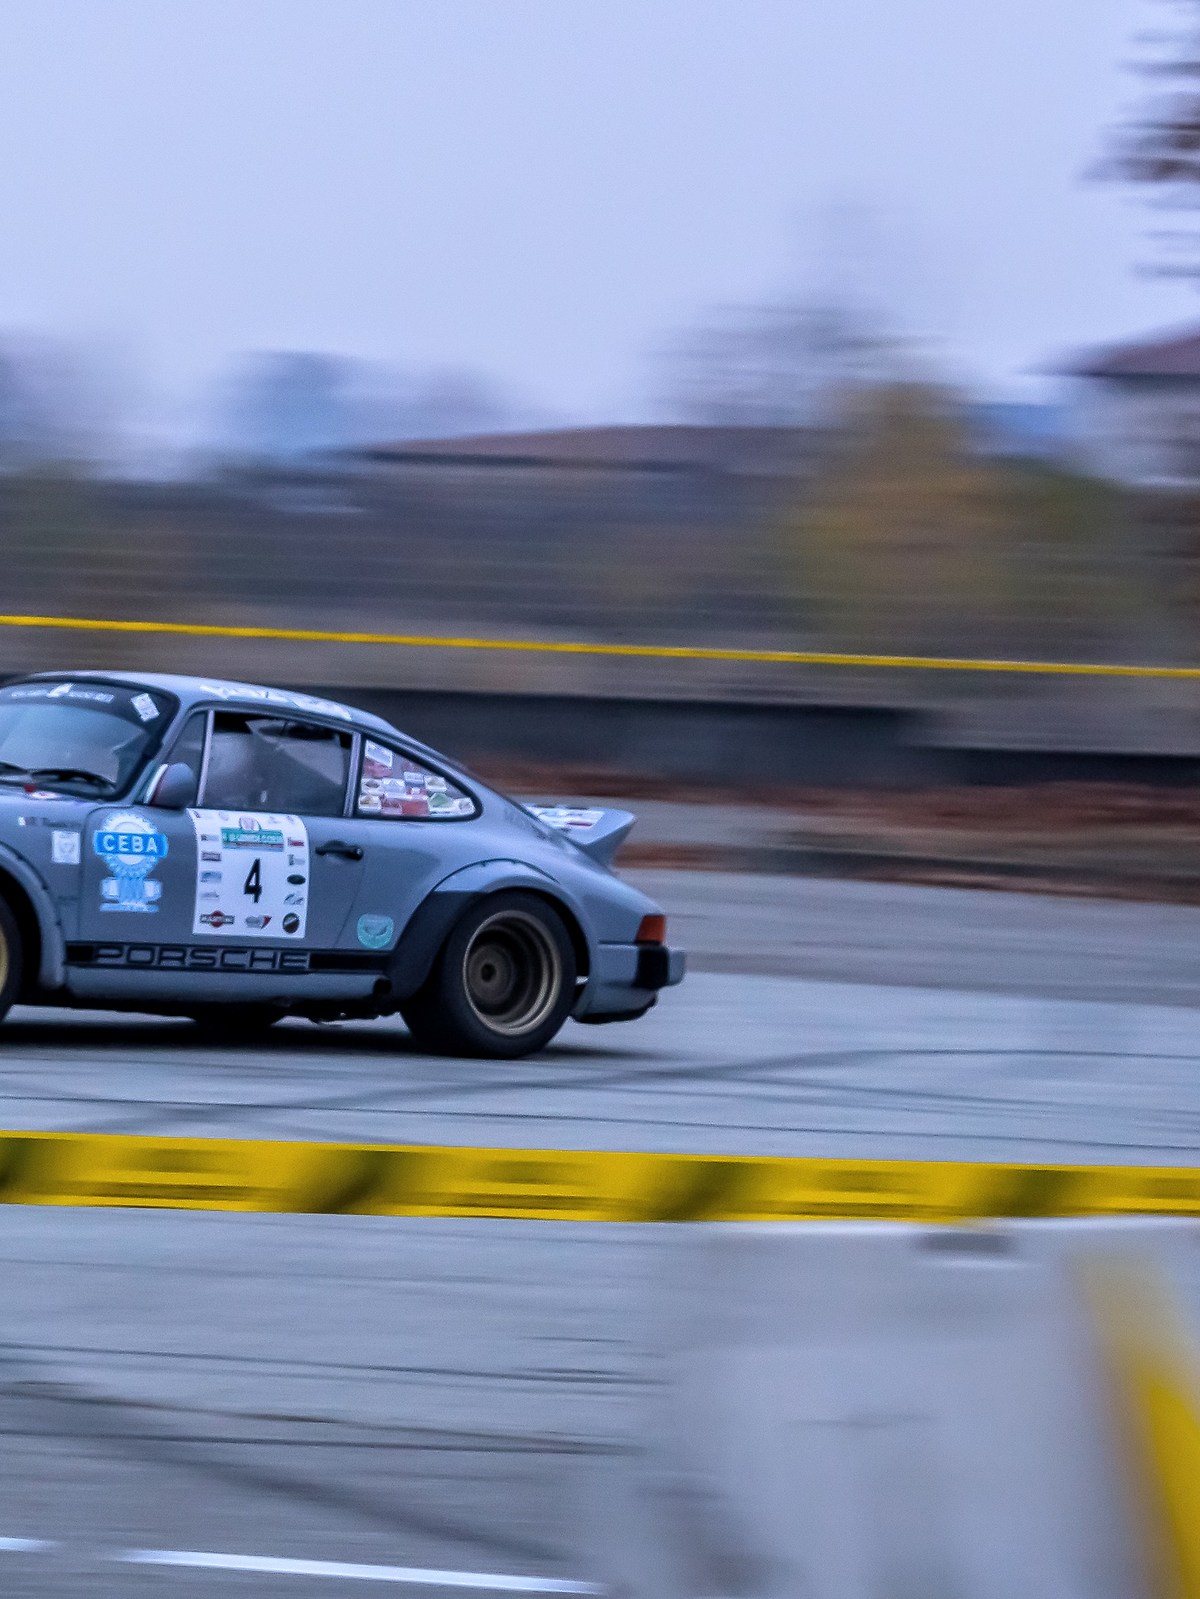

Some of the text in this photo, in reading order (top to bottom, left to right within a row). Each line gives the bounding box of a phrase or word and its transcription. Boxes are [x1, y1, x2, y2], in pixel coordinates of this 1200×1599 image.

[103, 835, 158, 853] CEBA
[244, 858, 262, 904] 4
[96, 947, 308, 969] PORSCHE
